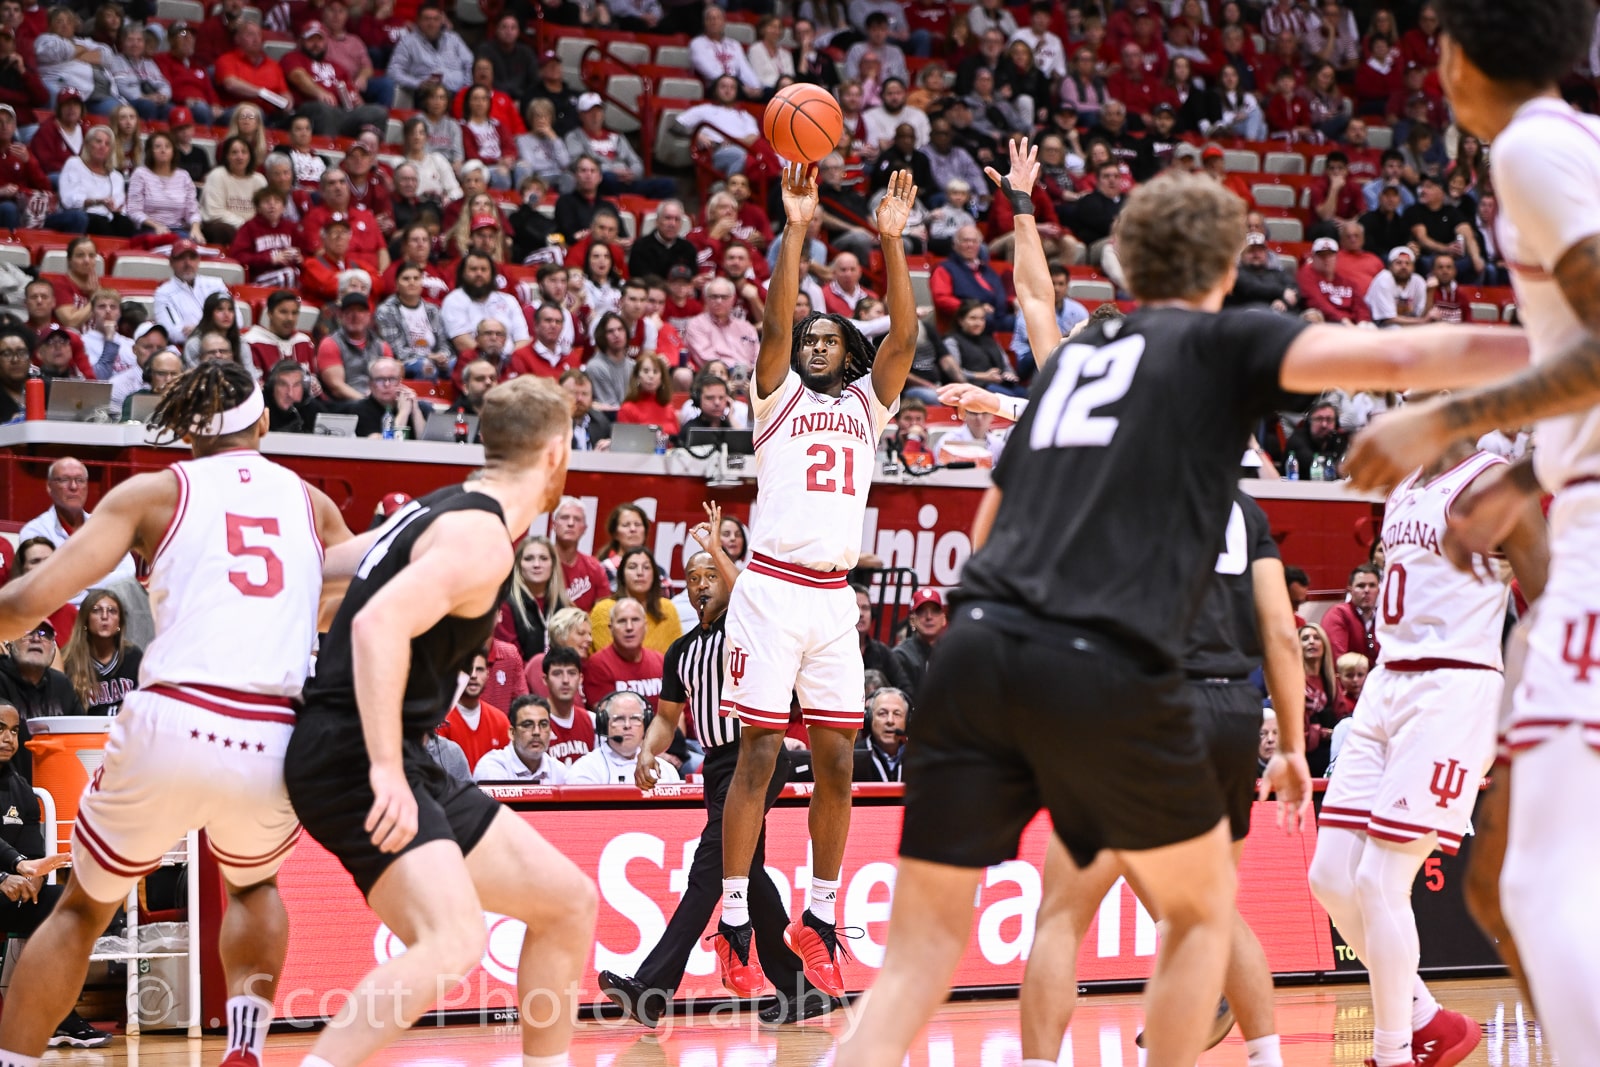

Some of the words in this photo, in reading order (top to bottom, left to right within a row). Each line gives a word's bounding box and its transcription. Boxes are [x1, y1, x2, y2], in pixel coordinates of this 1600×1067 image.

[1029, 333, 1146, 450] 12
[790, 411, 868, 445] INDIANA
[806, 443, 856, 496] 21
[225, 511, 285, 598] 5
[1383, 563, 1407, 625] 0
[1424, 857, 1445, 892] 5
